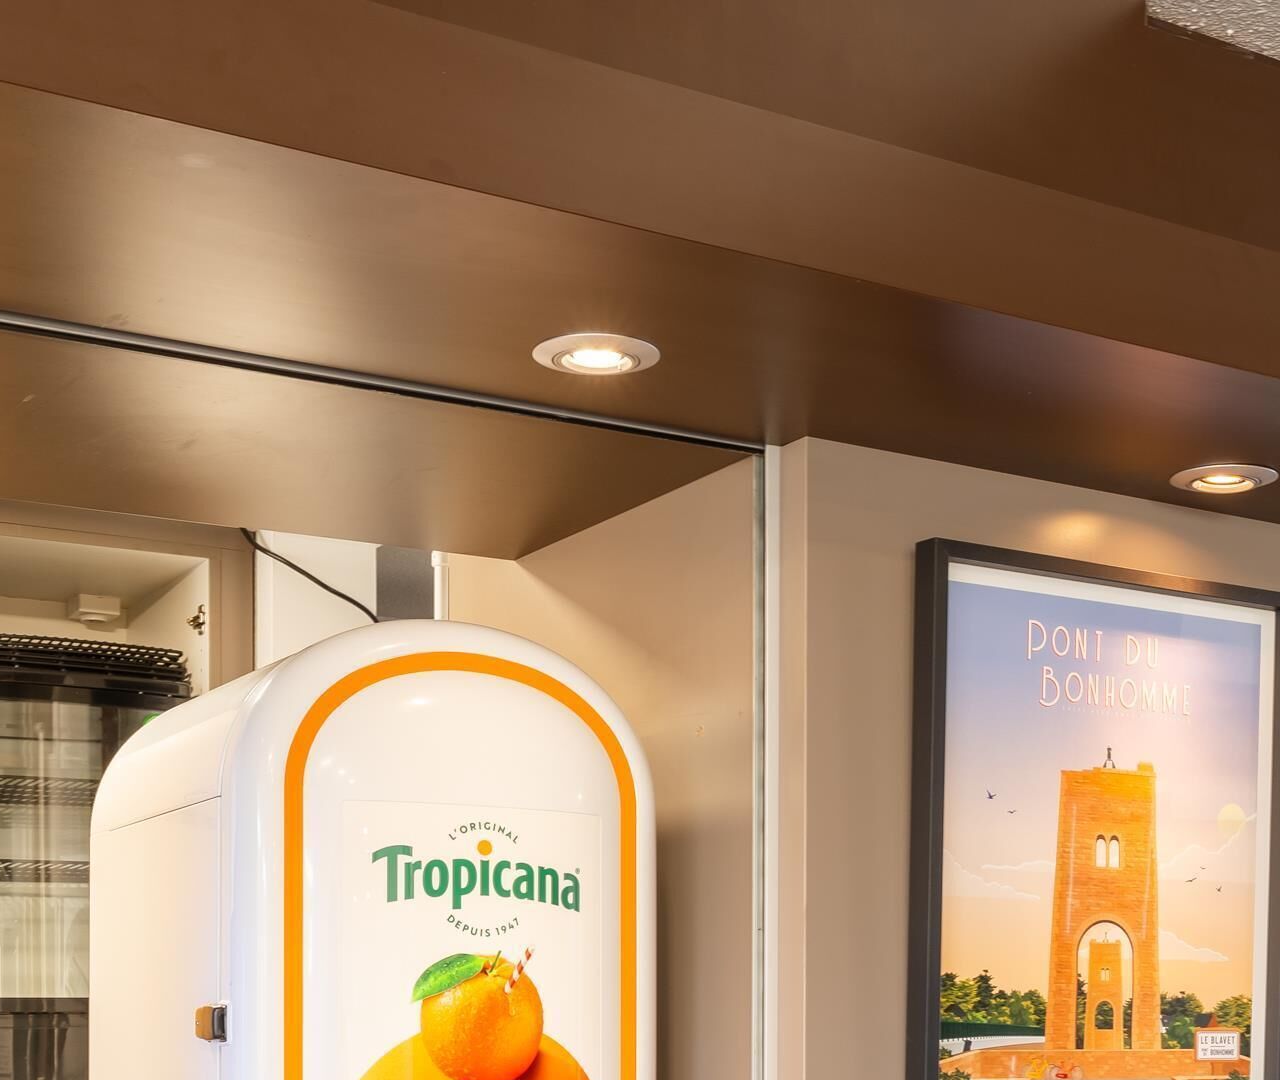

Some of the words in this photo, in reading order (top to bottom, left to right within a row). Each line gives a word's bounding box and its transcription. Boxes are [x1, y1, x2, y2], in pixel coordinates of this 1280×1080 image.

[1026, 619, 1103, 662] PONT
[1125, 634, 1159, 668] DU
[1039, 665, 1192, 716] BONHOMME
[448, 821, 520, 845] L'ORIGINAL
[371, 841, 581, 913] Tropicana
[446, 914, 491, 937] DEPUIS
[495, 917, 520, 936] 1947
